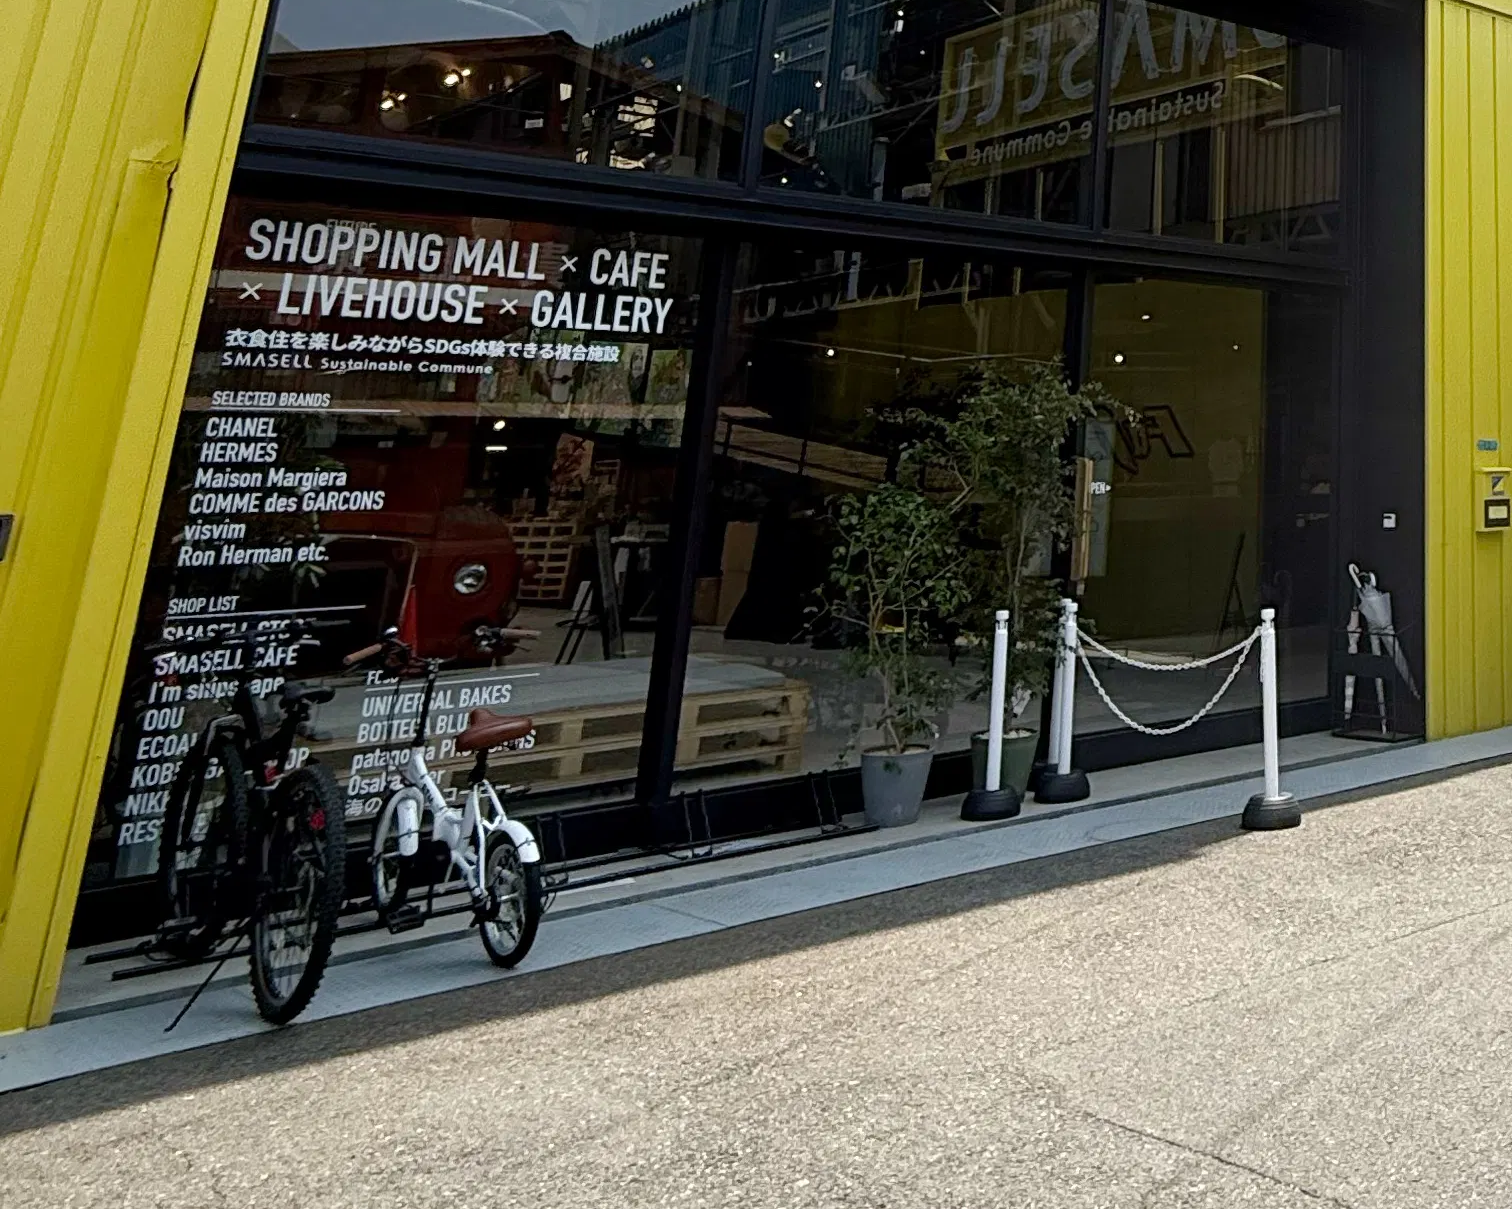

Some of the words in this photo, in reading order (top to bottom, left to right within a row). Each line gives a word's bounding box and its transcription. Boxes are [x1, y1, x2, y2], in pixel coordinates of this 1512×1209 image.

[245, 218, 444, 273] SHOPPING
[453, 236, 545, 281] MALL
[590, 248, 669, 289] CAFE
[277, 272, 489, 324] LIVEHOUSE
[531, 290, 674, 334] GALLERY
[222, 352, 313, 369] SMASELL
[320, 358, 412, 372] Sustainable
[418, 361, 494, 374] Commune
[212, 390, 276, 406] SELECTED
[279, 393, 331, 407] BRANDS
[206, 417, 278, 438] CHANEL
[200, 442, 278, 463] HERMES
[194, 467, 262, 488] Maison
[266, 467, 347, 491] Margiera
[189, 493, 262, 514] COMME
[264, 493, 298, 512] des
[302, 490, 385, 511] GARCONS
[185, 519, 246, 541] visvim
[178, 545, 215, 567] Ron
[220, 544, 292, 566] Herman
[298, 543, 329, 562] etc.
[168, 597, 206, 614] SHOP
[208, 595, 240, 612] LIST
[148, 681, 182, 704] I'm
[459, 684, 512, 708] BAKES
